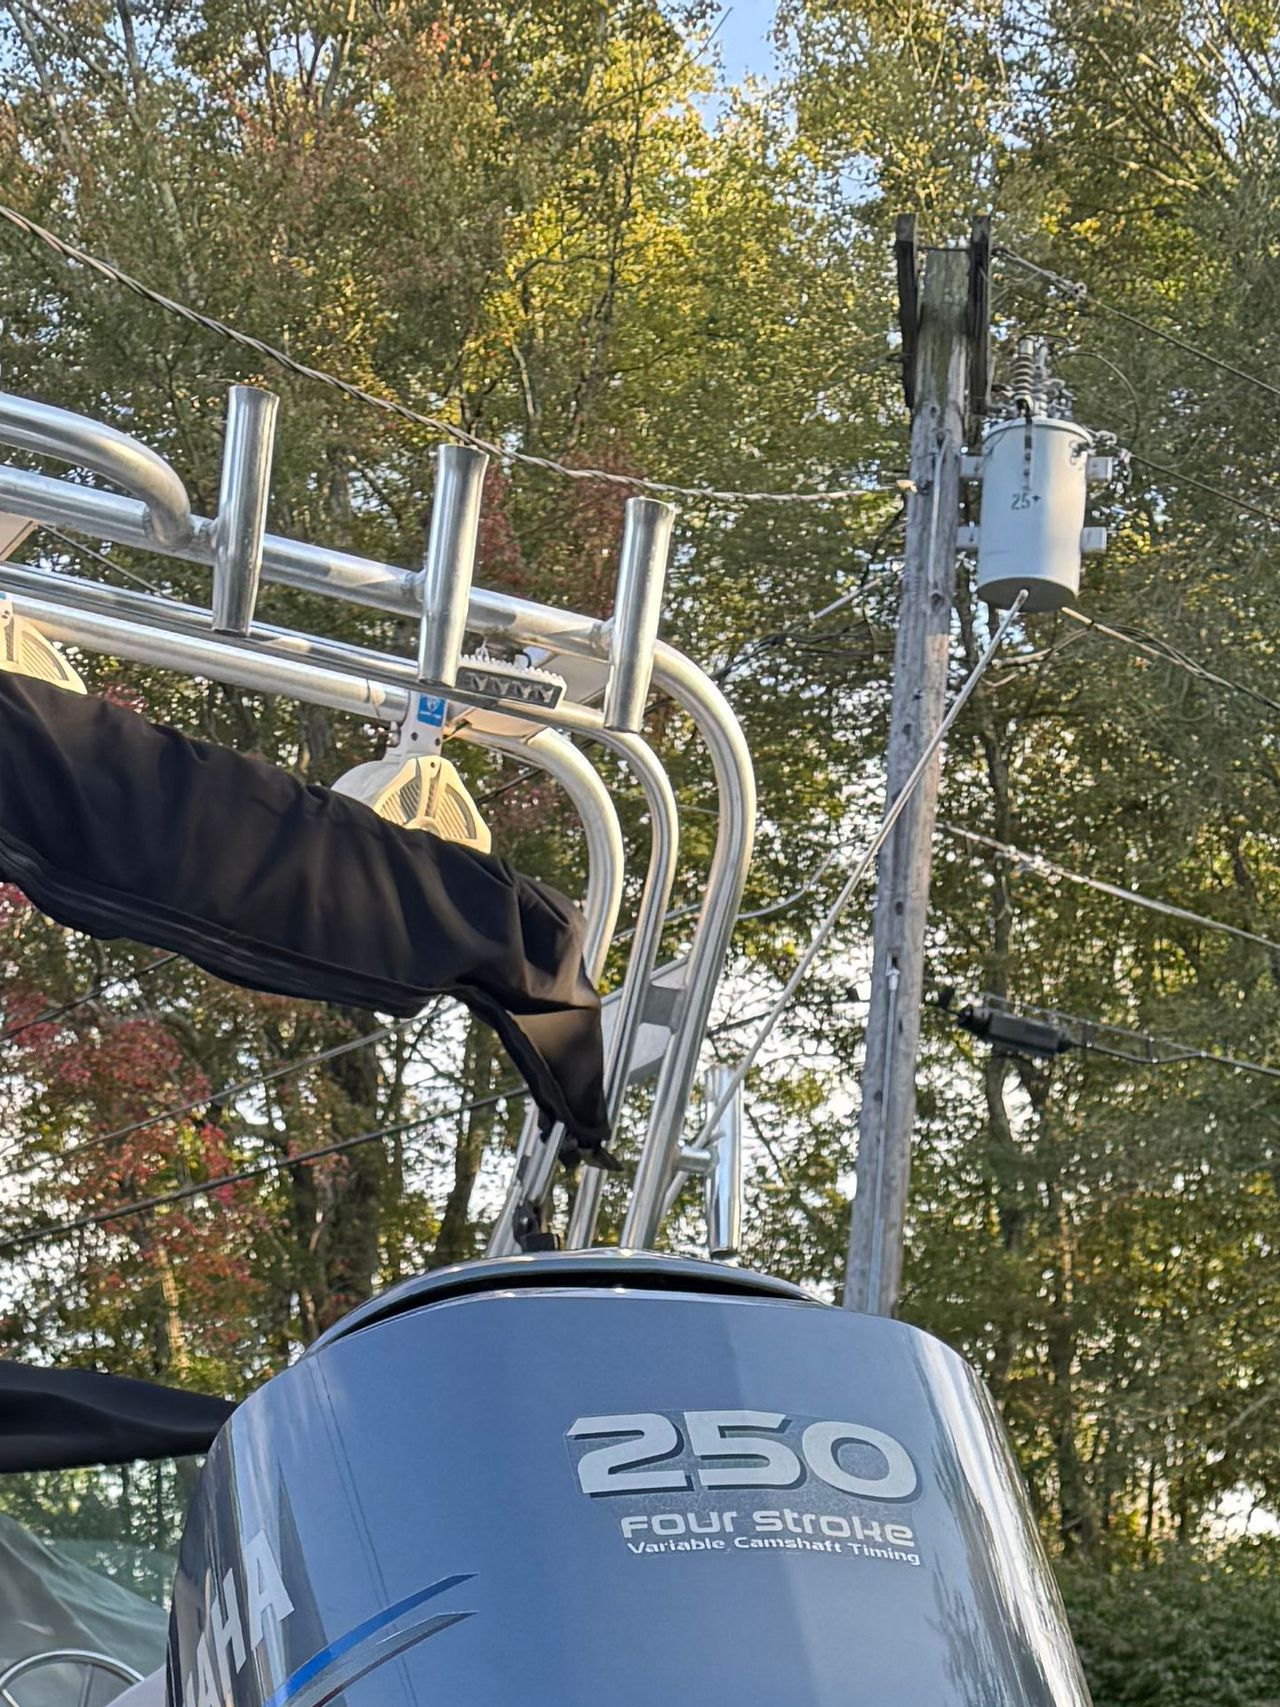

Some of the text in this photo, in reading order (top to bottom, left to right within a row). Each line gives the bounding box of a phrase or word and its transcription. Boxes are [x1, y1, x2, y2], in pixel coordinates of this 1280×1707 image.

[567, 1409, 923, 1505] 250
[627, 1536, 922, 1566] Variable Camshaft Timing
